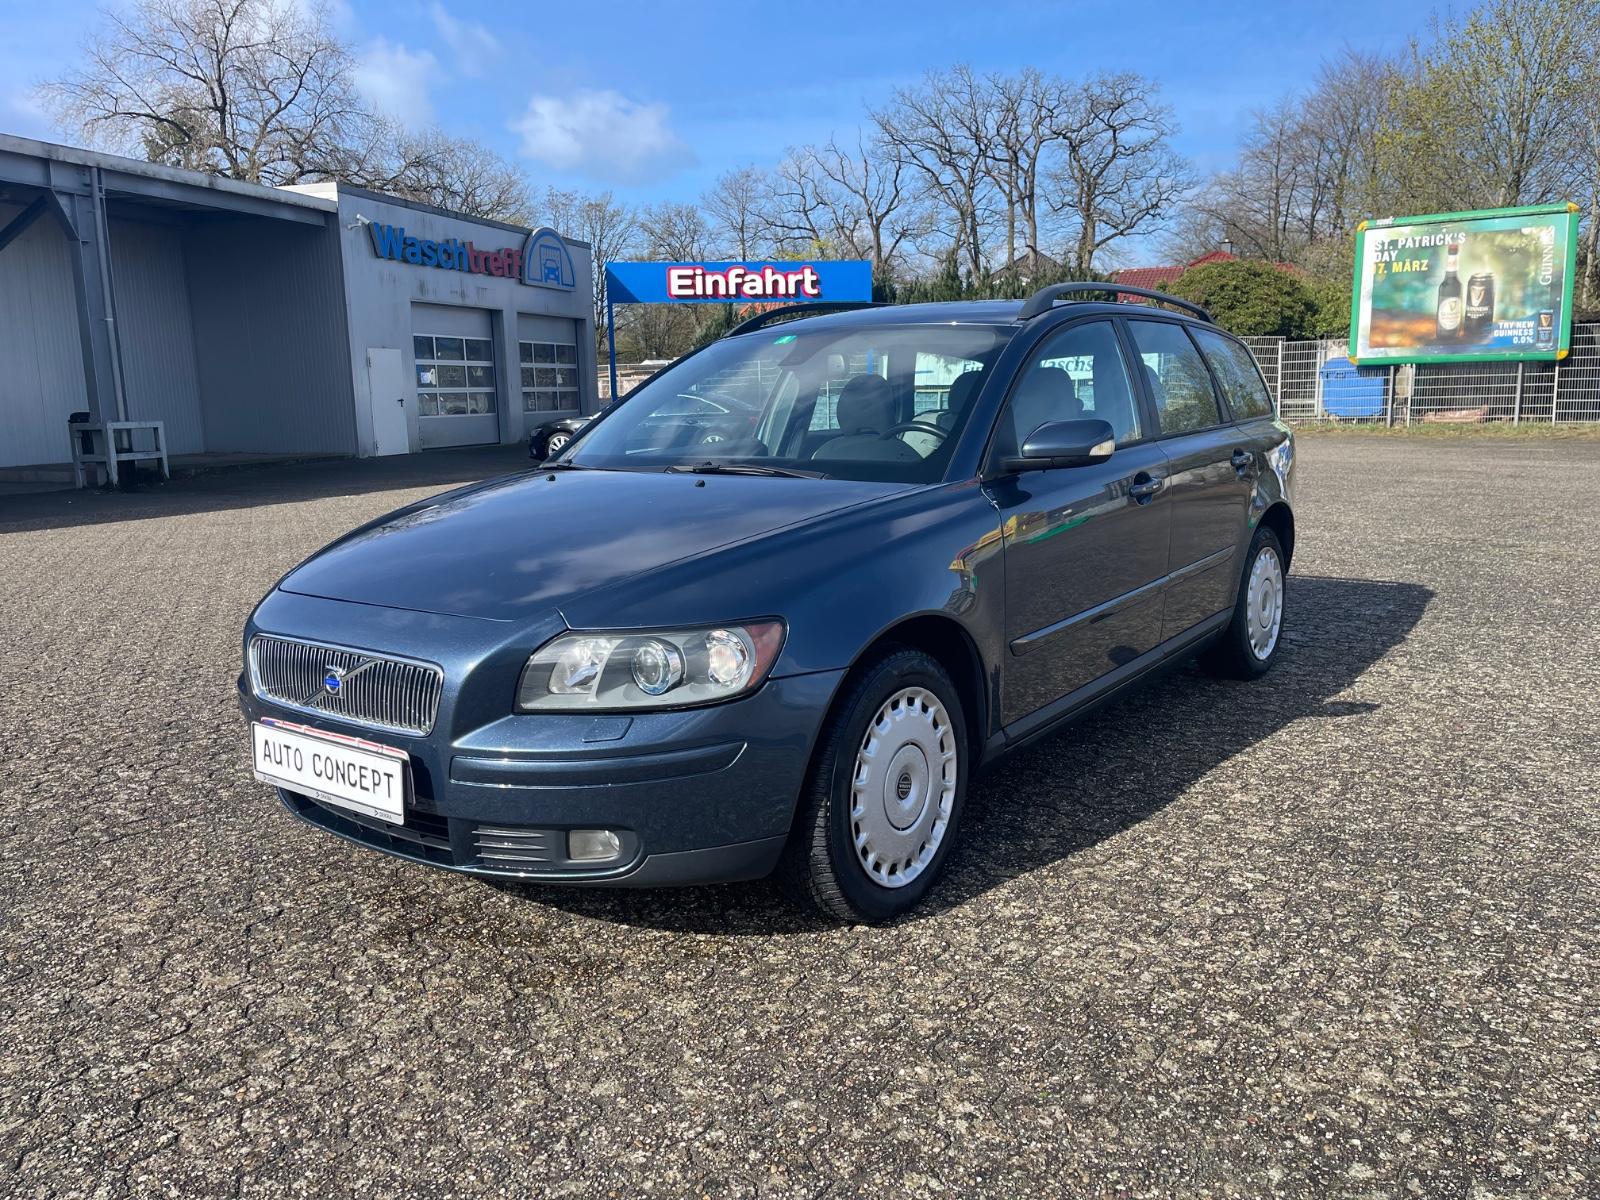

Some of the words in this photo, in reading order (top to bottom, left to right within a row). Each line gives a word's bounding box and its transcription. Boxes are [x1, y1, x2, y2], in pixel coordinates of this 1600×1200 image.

[1375, 240, 1393, 251] ST.
[1398, 232, 1466, 249] PATRICK'S
[370, 221, 523, 279] Waschtreff
[1375, 250, 1398, 262] DAY
[1392, 259, 1429, 273] MÄRZ
[668, 266, 819, 296] Einfahrt
[1517, 321, 1535, 329] NEW
[1494, 329, 1534, 337] GUINNESS
[1513, 336, 1534, 344] 0.0%
[263, 739, 303, 772] AUTO
[312, 753, 394, 798] CONCEPT
